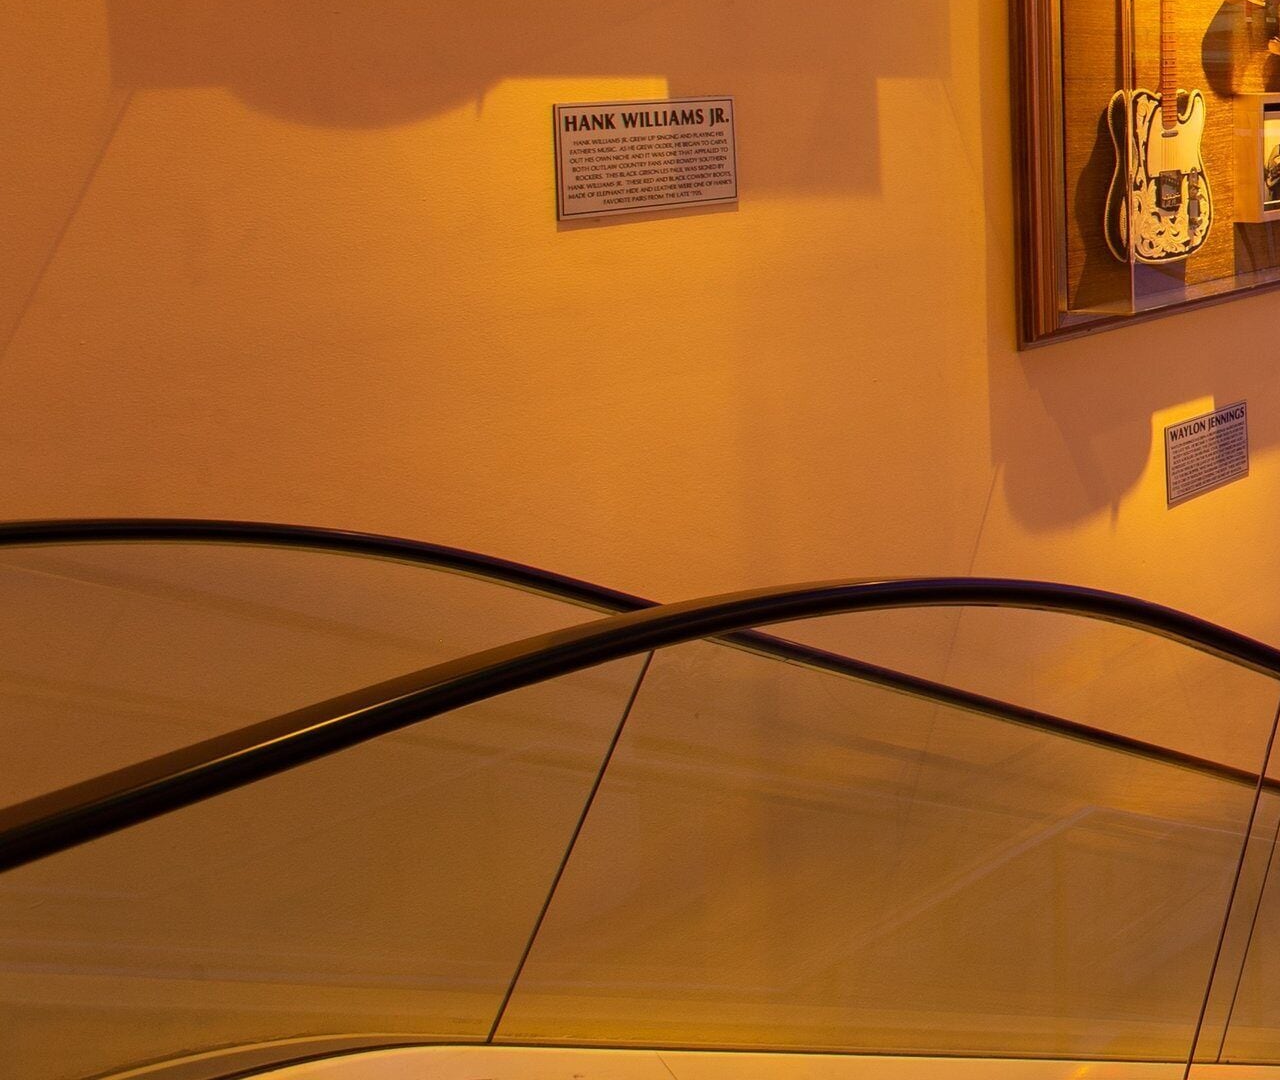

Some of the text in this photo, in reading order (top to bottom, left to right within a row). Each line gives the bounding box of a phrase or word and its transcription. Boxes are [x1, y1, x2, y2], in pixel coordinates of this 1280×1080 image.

[564, 107, 730, 132] HANK WILLIAMS JR.
[596, 189, 625, 197] ELEPHANT
[603, 197, 630, 205] FAVORITE
[1170, 407, 1244, 441] WAYLON JENNINGS
